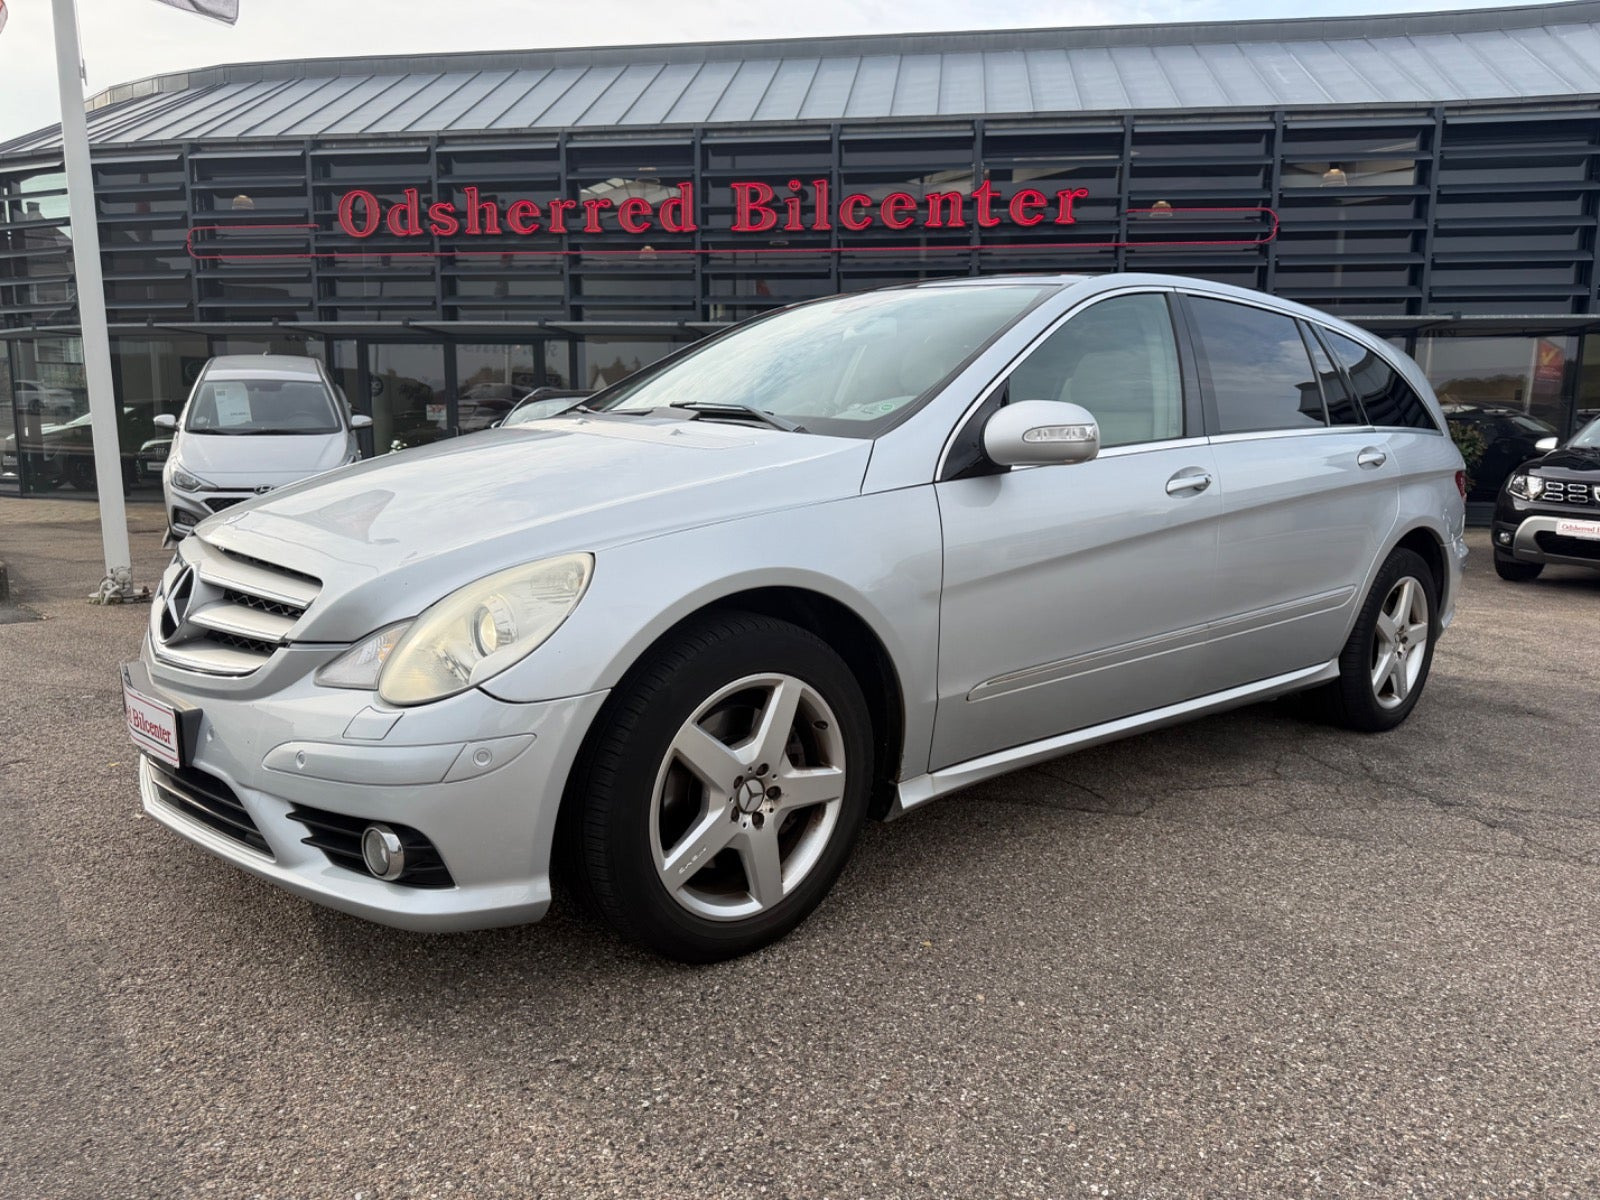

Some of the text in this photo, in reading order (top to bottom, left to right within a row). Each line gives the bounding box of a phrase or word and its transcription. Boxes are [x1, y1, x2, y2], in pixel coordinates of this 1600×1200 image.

[338, 179, 1090, 237] Odsherred Bilcenter
[132, 707, 172, 744] Bilcenter
